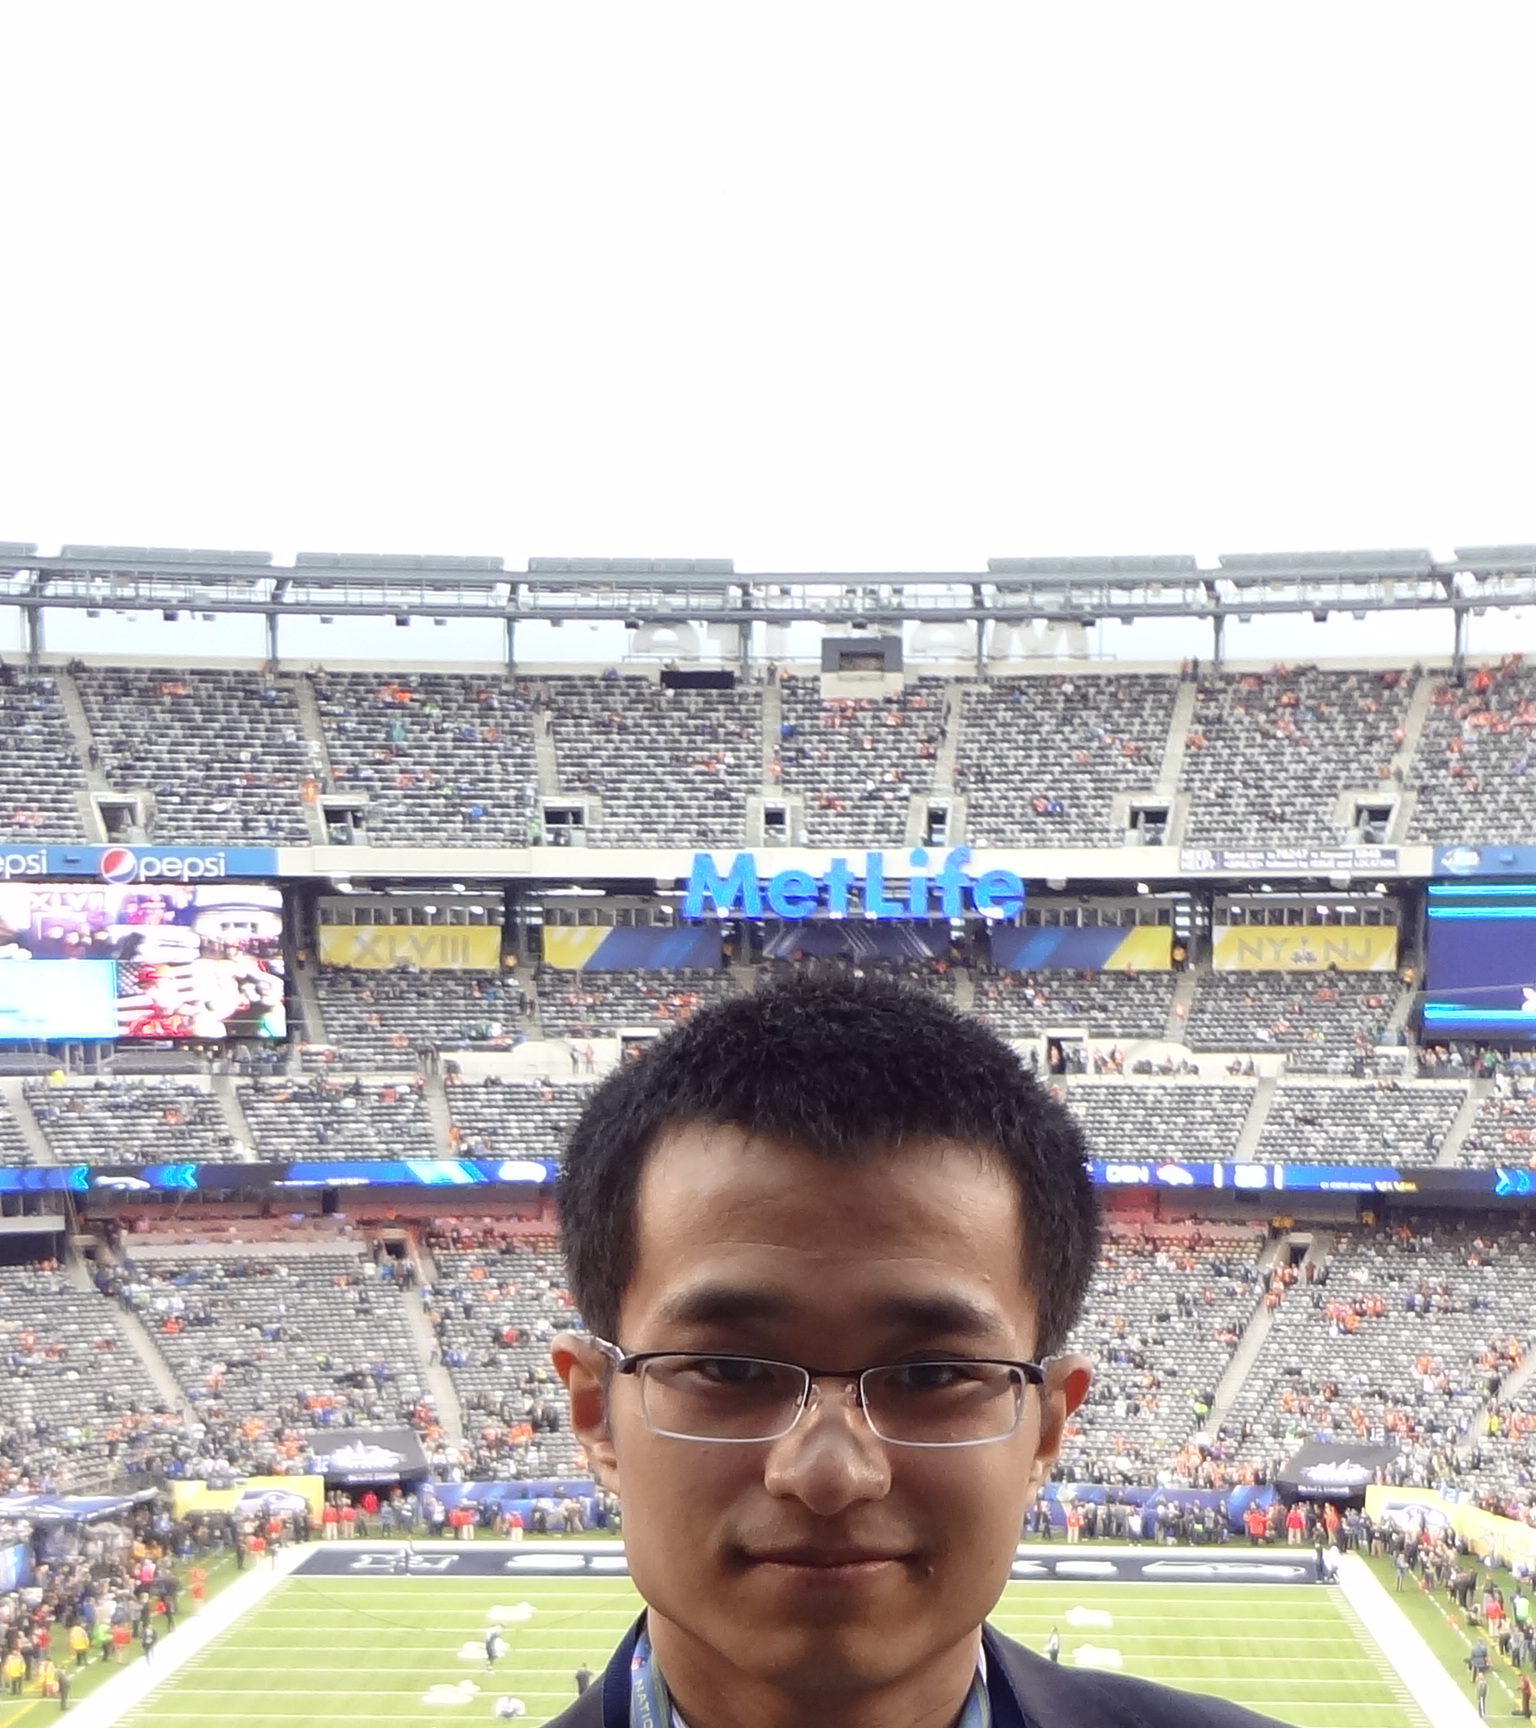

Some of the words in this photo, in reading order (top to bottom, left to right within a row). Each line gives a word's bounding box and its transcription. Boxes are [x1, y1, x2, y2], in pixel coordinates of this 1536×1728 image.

[136, 851, 225, 880] pepsi
[683, 846, 1025, 919] MetLife
[353, 935, 470, 963] XLVIII
[1237, 936, 1290, 962] NY
[1323, 936, 1372, 963] NJ
